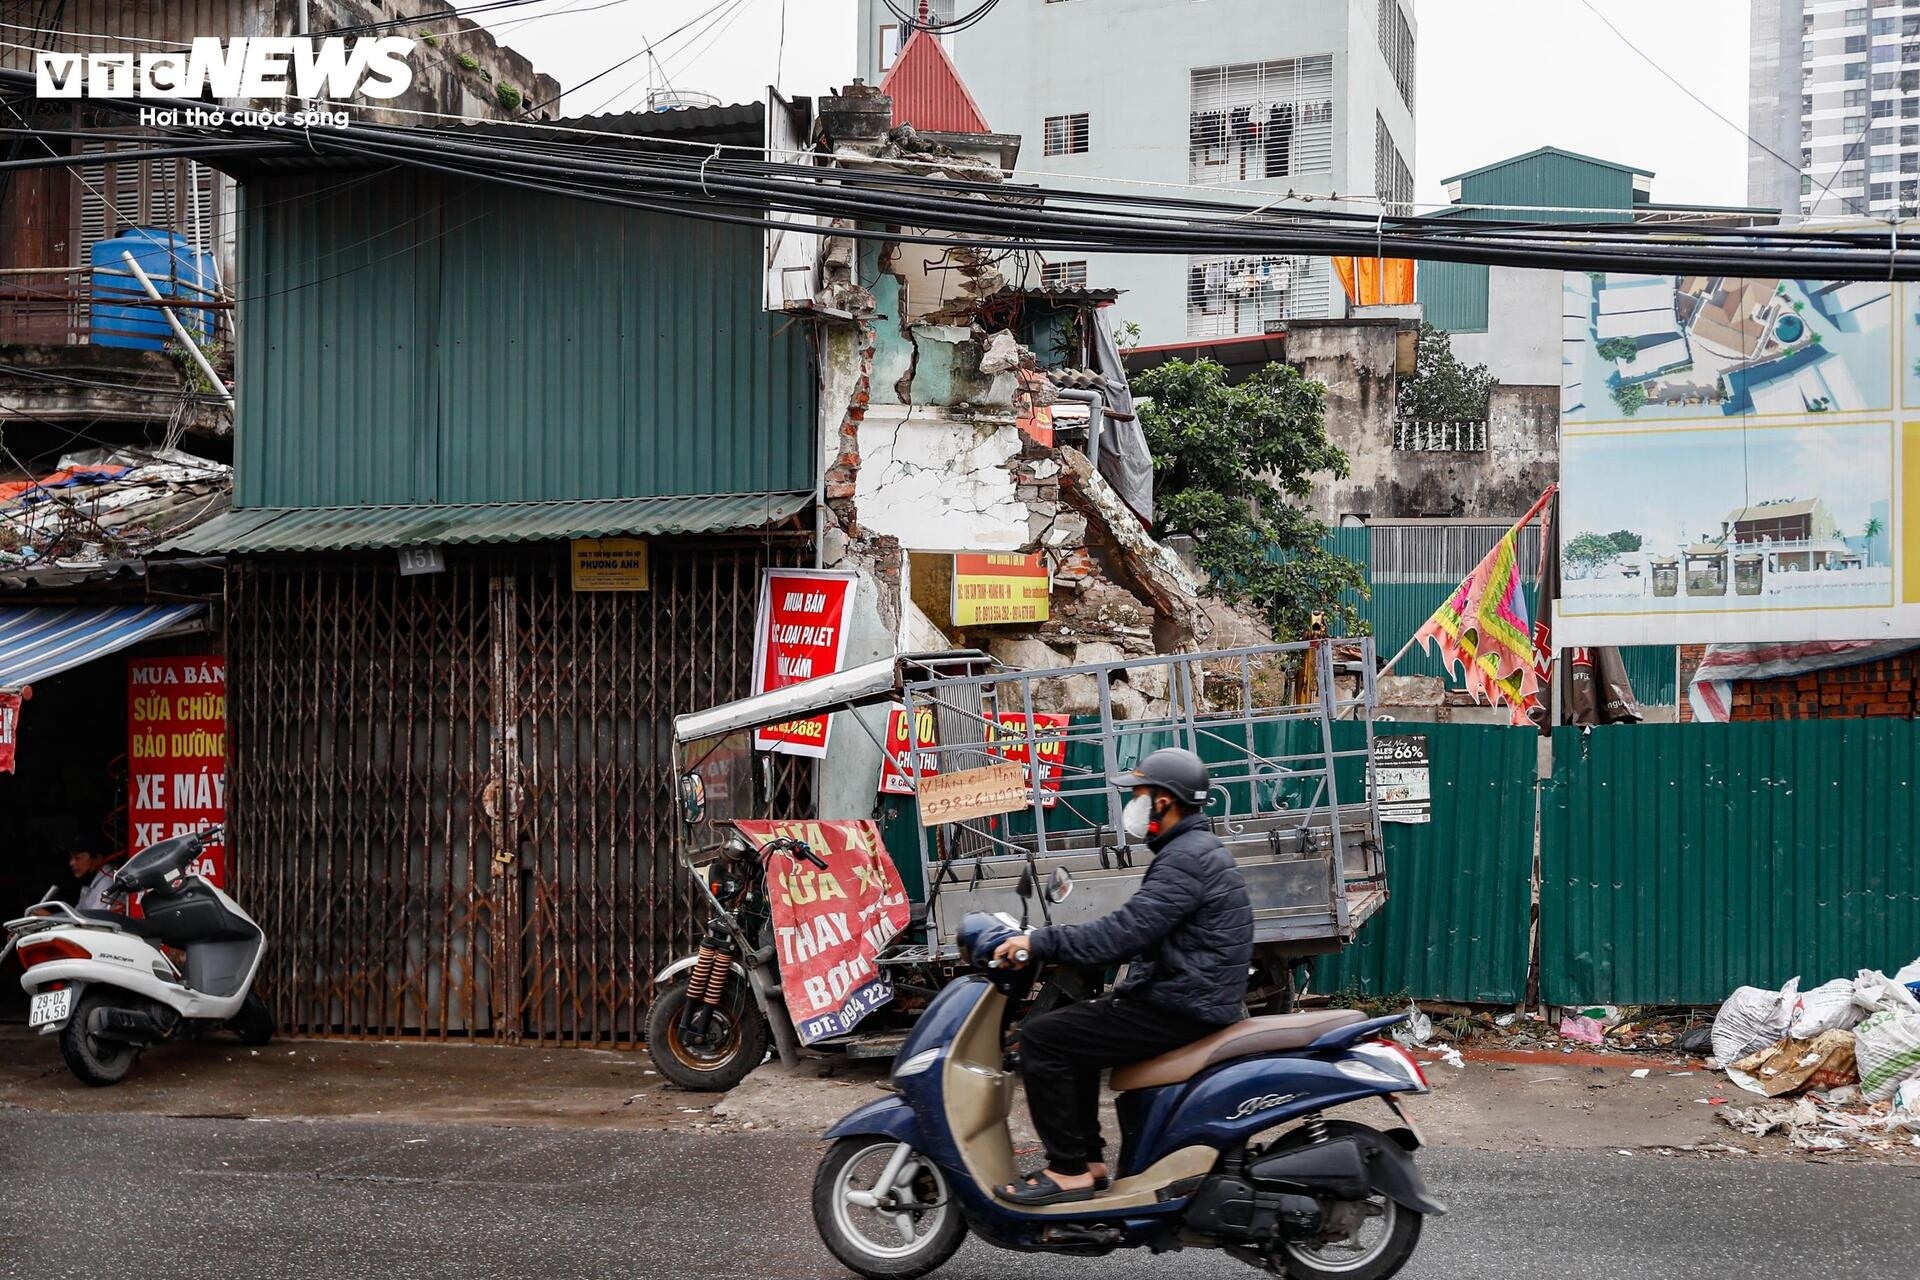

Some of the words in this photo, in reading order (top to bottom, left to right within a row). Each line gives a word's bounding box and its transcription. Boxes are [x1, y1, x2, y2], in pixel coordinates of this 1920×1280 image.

[405, 550, 436, 569] 151
[620, 561, 639, 569] ANH
[783, 592, 804, 612] MUA
[804, 590, 827, 613] BÁN
[780, 624, 803, 649] LOẠI
[132, 667, 179, 685] MUA
[184, 661, 225, 684] BÁN
[134, 689, 171, 721] SỬA
[177, 692, 225, 720] CHỮA
[133, 726, 166, 758] BẢO
[1394, 745, 1424, 759] 66%
[136, 774, 166, 810] XE
[174, 765, 225, 809] MÁY
[135, 823, 165, 848] XE
[778, 912, 856, 965] THAY
[31, 1004, 67, 1023] 014.58
[808, 1016, 838, 1037] ĐT:
